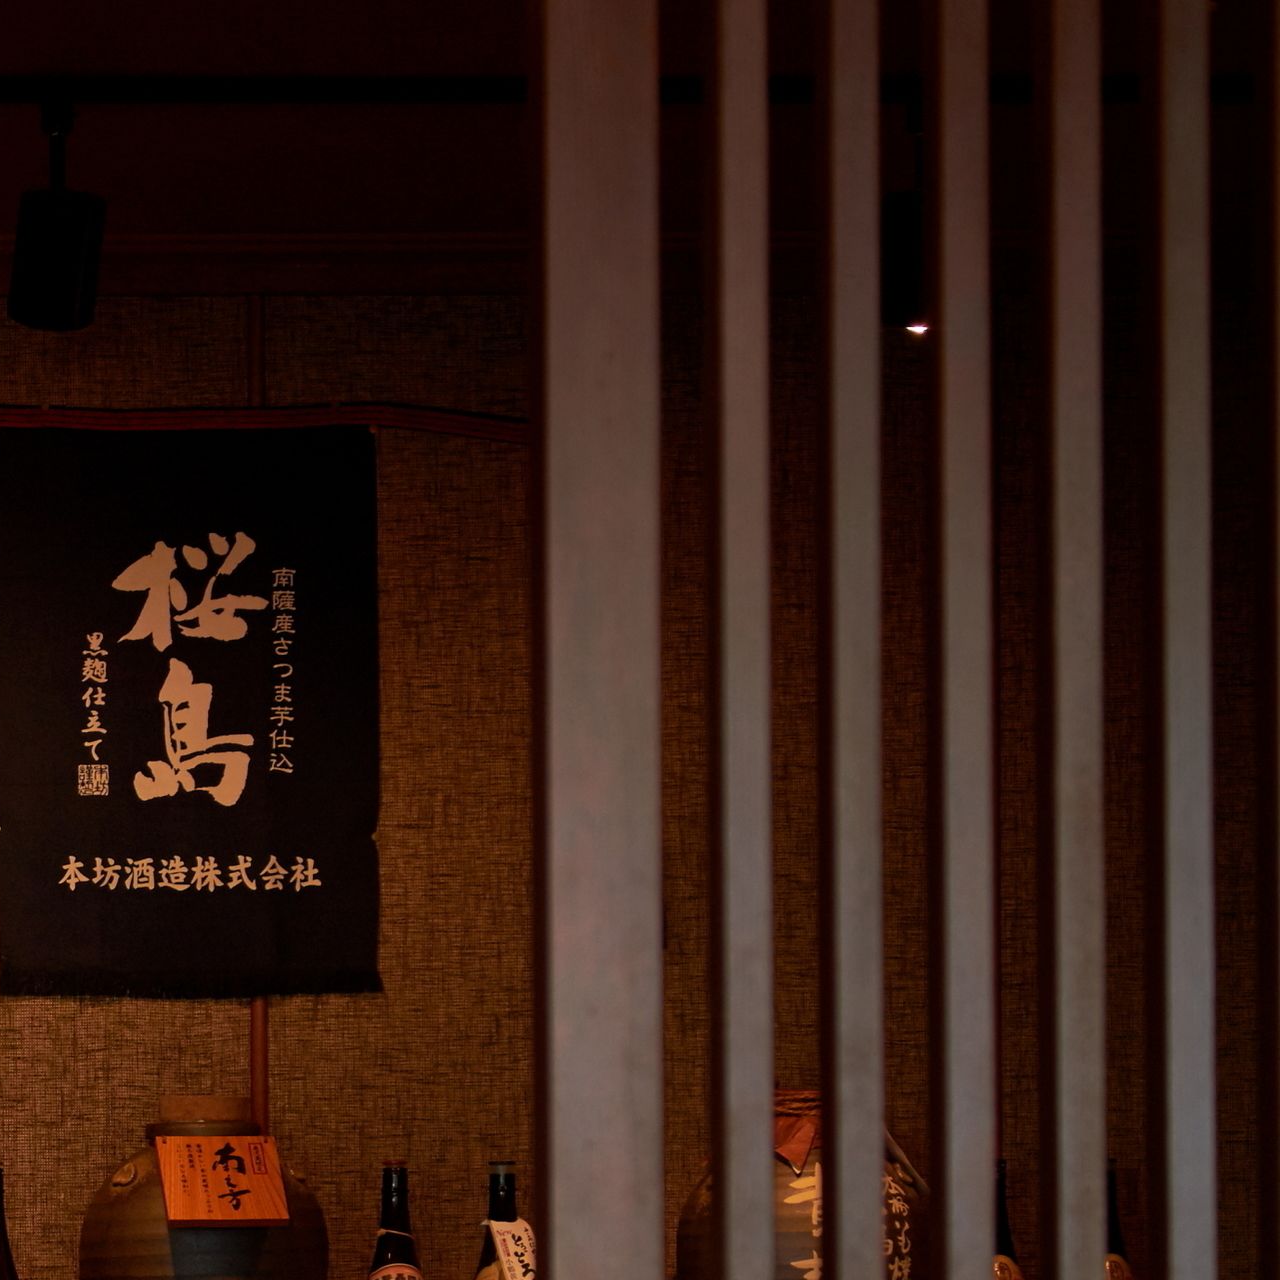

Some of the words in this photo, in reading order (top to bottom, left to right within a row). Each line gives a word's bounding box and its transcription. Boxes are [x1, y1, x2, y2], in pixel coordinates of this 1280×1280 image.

[111, 532, 269, 806] 桜島
[269, 567, 297, 774] 南薩産さつま芋仕込
[58, 855, 322, 892] 本坊酒造株式会社
